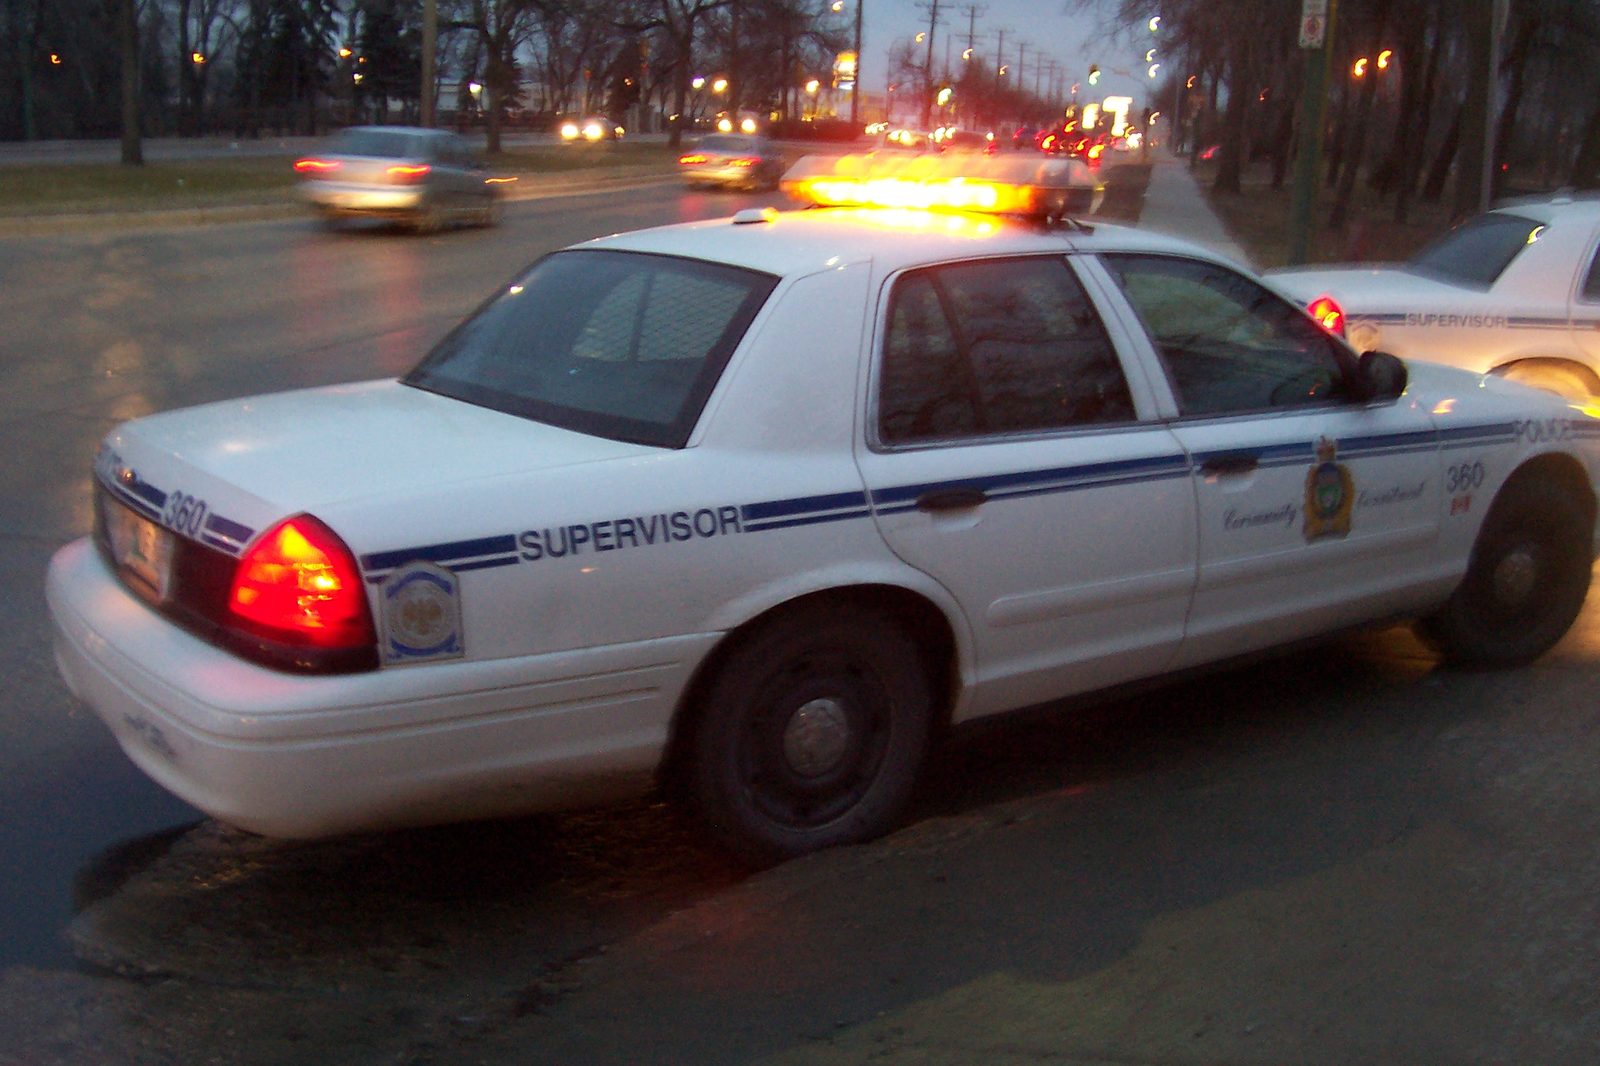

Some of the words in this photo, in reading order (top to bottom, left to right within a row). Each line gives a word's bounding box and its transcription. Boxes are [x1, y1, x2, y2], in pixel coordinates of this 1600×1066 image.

[1406, 313, 1508, 330] SUPERVISOR
[1446, 461, 1485, 494] 360
[165, 490, 207, 537] 360
[519, 505, 742, 561] SUPERVISOR
